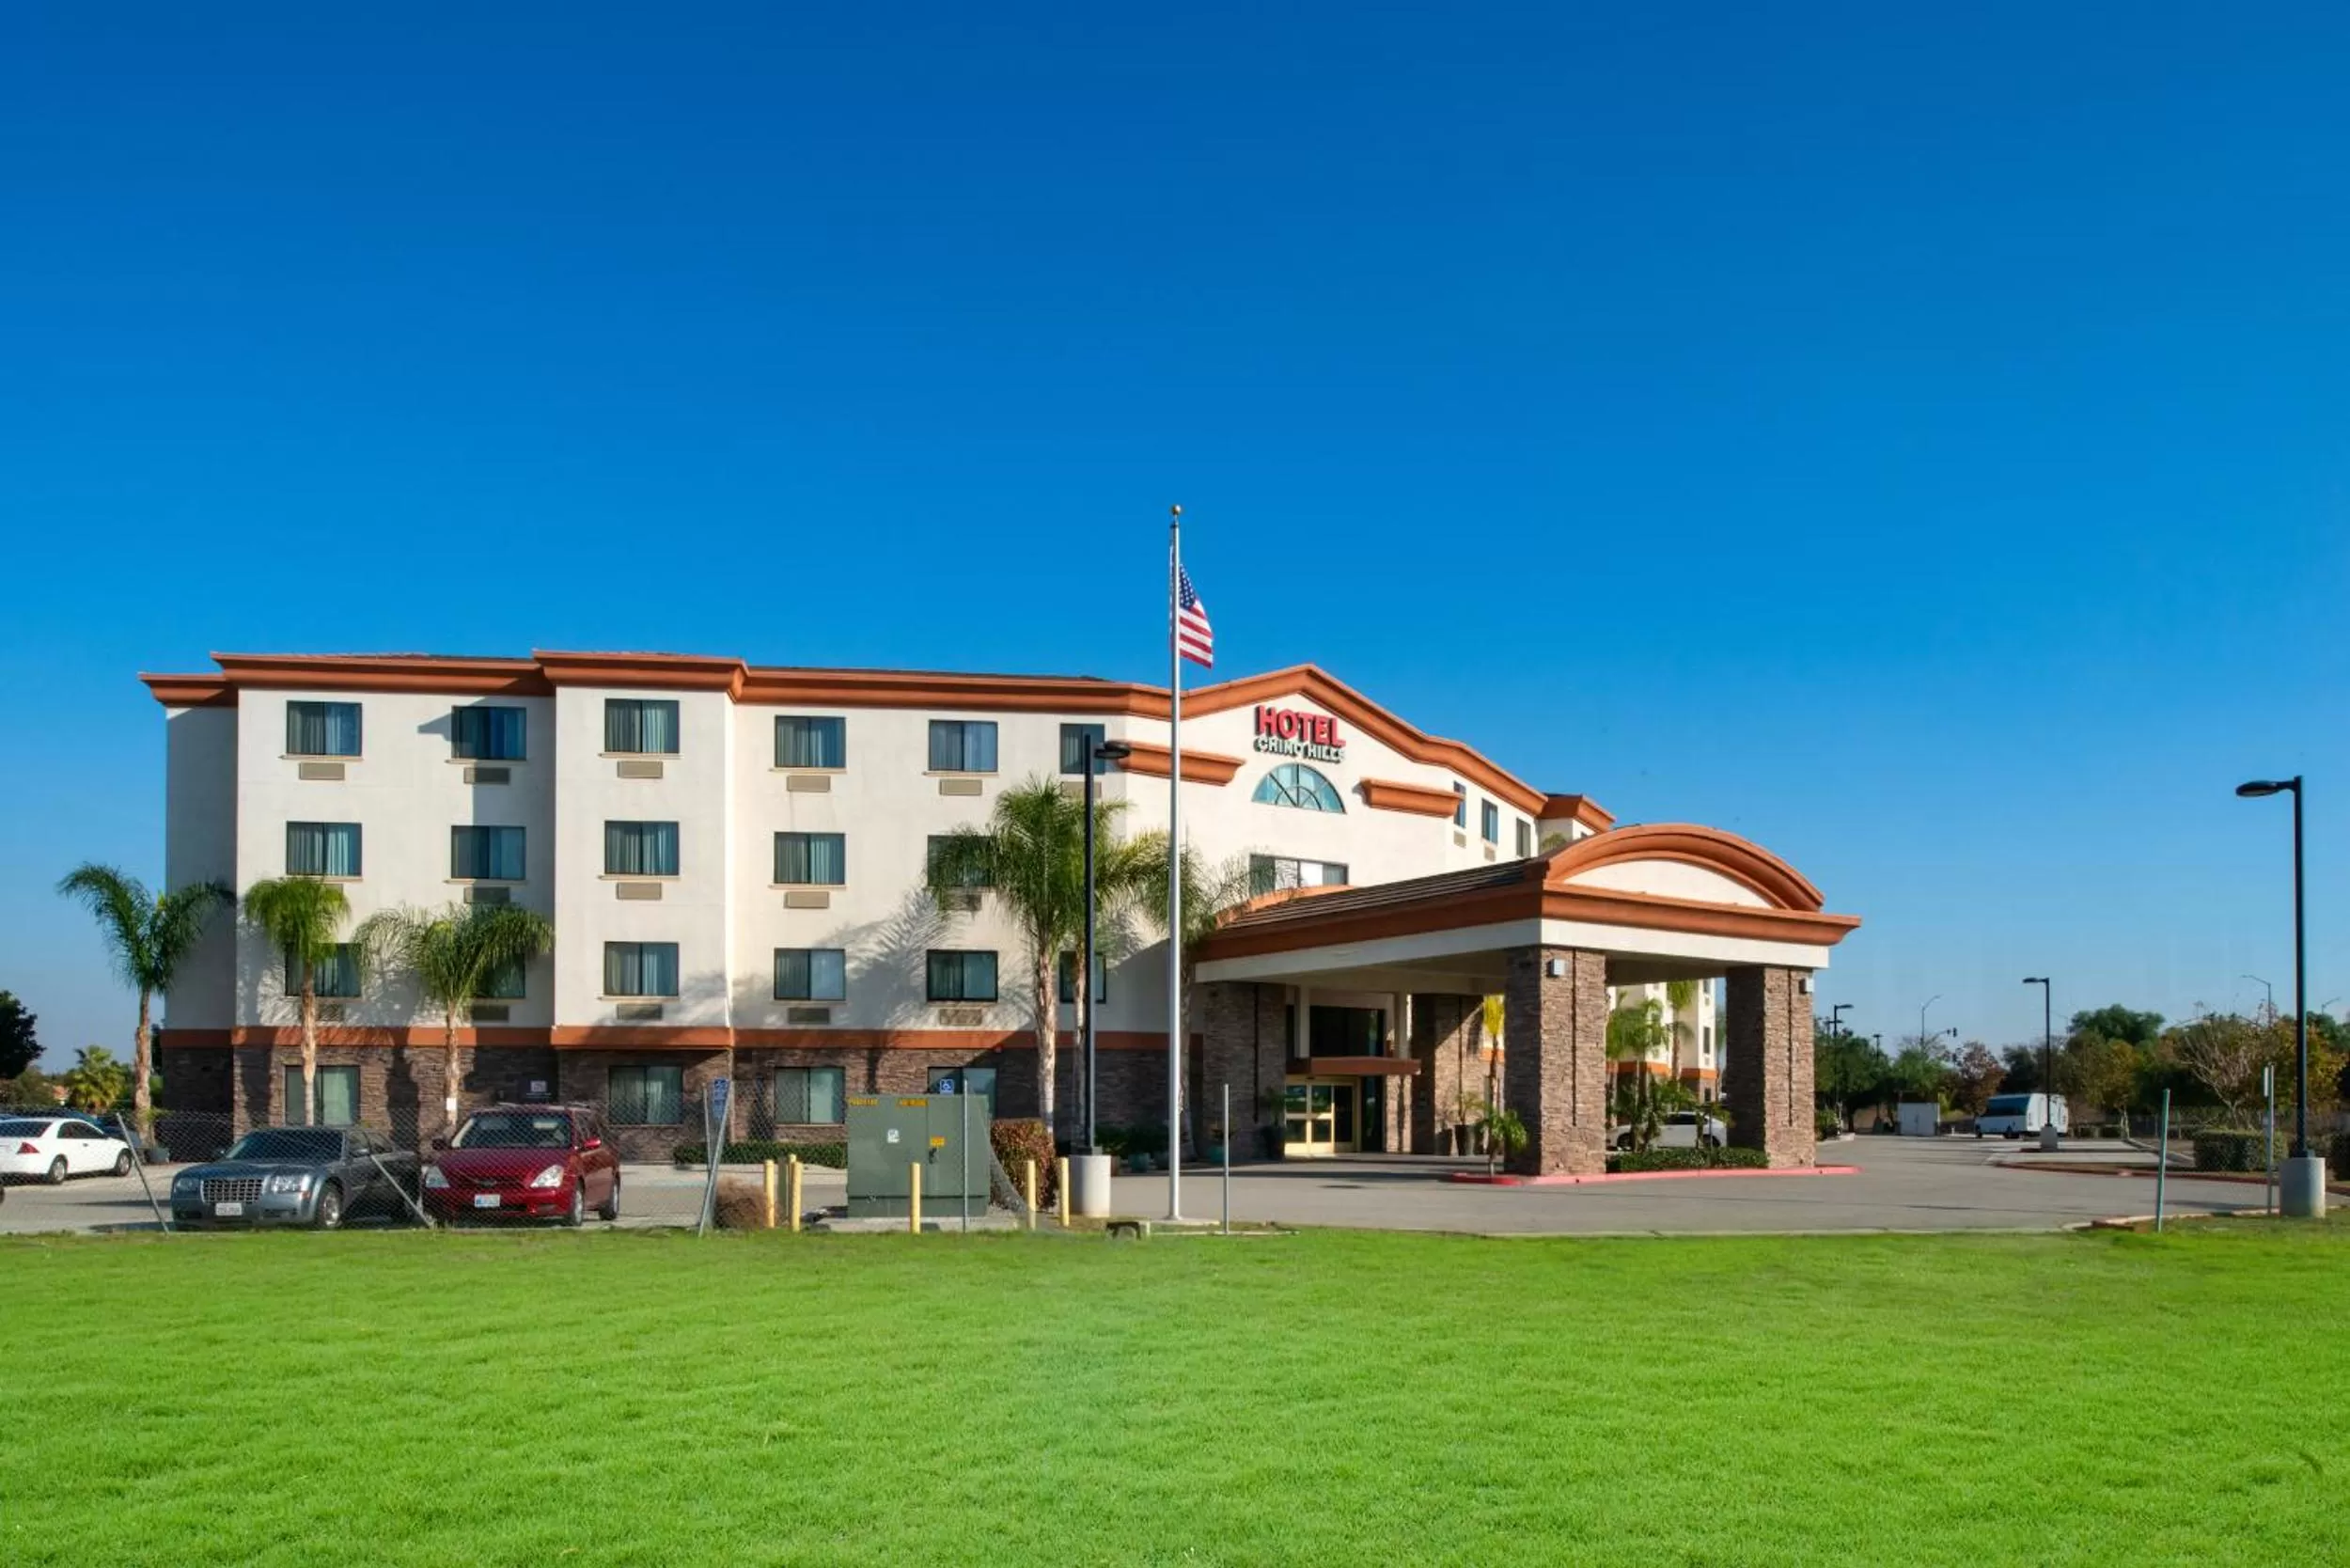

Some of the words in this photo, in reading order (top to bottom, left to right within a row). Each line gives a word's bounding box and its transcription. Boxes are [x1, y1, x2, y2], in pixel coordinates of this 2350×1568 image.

[1255, 705, 1346, 748] HOTEL
[1253, 736, 1305, 757] CHINO
[1304, 742, 1344, 763] HILLS
